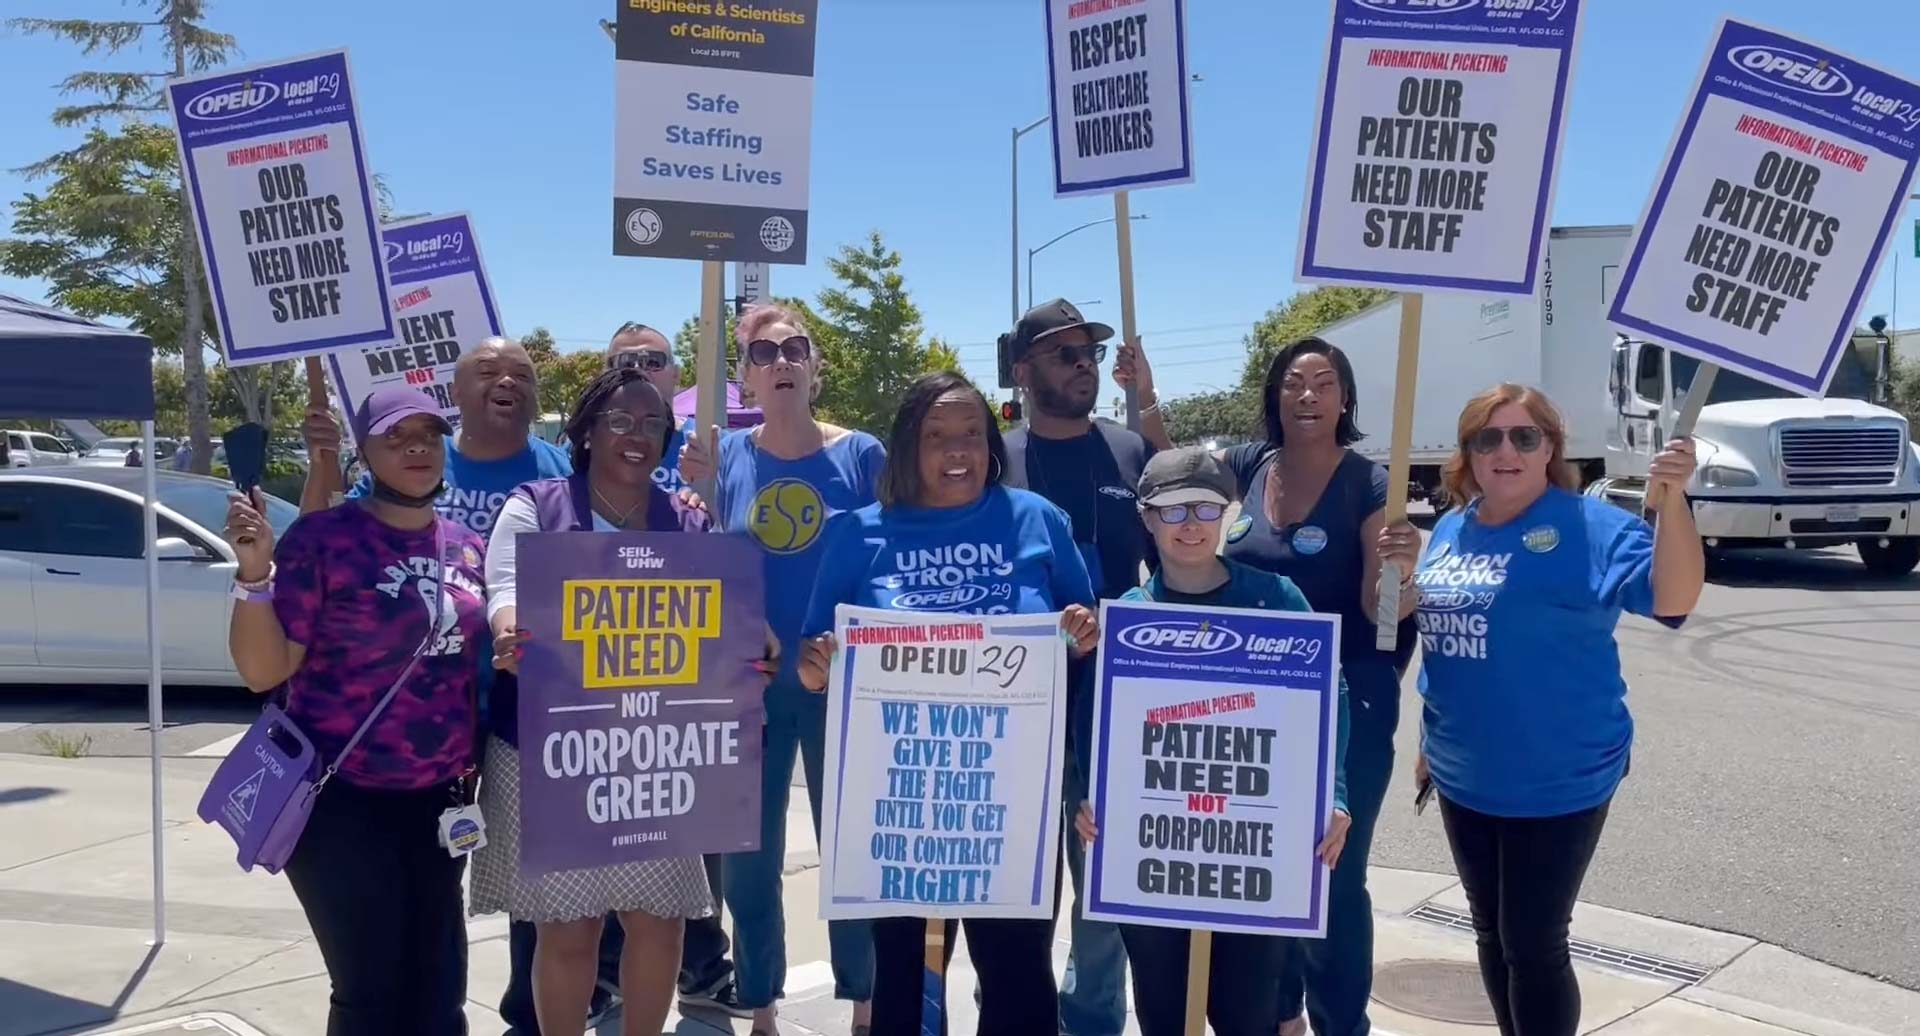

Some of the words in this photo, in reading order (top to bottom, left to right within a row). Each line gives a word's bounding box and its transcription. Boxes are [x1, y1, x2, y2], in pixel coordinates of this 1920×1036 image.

[629, 0, 711, 15] Engineers
[714, 4, 727, 16] &
[730, 4, 805, 25] Scientists
[670, 23, 688, 36] of
[690, 23, 765, 44] California
[690, 48, 710, 56] Local
[1069, 14, 1147, 71] RESPECT
[1367, 49, 1449, 71] INFORMATIONAL
[1450, 53, 1508, 73] PICKETING
[196, 86, 265, 115] OPEIU
[284, 76, 318, 98] Local
[318, 73, 340, 98] 29
[686, 92, 740, 114] Safe
[1073, 71, 1149, 116] HEALTHCARE
[1397, 76, 1463, 118] OUR
[1743, 50, 1840, 91] OPEIU
[1852, 85, 1902, 115] Local
[1894, 102, 1920, 132] 29
[227, 140, 288, 166] INFORMATIONAL
[289, 134, 328, 155] PICKETING
[665, 125, 762, 155] Staffing
[1075, 109, 1154, 158] WORKERS
[1357, 116, 1498, 164] PATIENTS
[1735, 114, 1818, 156] INFORMATIONAL
[1813, 143, 1868, 172] PICKETING
[258, 163, 308, 203] OUR
[642, 157, 714, 180] Saves
[722, 163, 782, 185] Lives
[1351, 163, 1413, 206] NEED
[1415, 167, 1488, 211] MORE
[1753, 151, 1821, 205] OUR
[240, 194, 343, 245] PATIENTS
[1363, 208, 1464, 252] STAFF
[1702, 178, 1840, 257] PATIENTS
[248, 247, 295, 286] NEED
[295, 237, 350, 279] MORE
[407, 235, 441, 255] Local
[442, 232, 463, 254] 29
[1684, 224, 1752, 278] NEED
[1746, 244, 1821, 302] MORE
[268, 279, 341, 323] STAFF
[1685, 272, 1787, 336] STAFF
[365, 341, 461, 376] NEED
[404, 368, 435, 385] NOT
[434, 487, 507, 509] UNIO
[618, 547, 655, 558] SEIU-
[626, 558, 665, 569] UHW
[896, 543, 1003, 571] UNION
[574, 586, 712, 631] PATIENT
[903, 586, 975, 606] OPEIU
[991, 583, 1012, 600] 29
[1476, 592, 1496, 610] 29
[846, 626, 928, 645] INFORMATIONAL
[930, 623, 984, 642] PICKETING
[1416, 612, 1488, 636] BRING
[597, 634, 686, 678] NEED
[1133, 627, 1228, 650] OPEIU
[1245, 633, 1293, 654] Local
[1291, 638, 1322, 665] 29
[1442, 635, 1487, 659] ON!
[881, 645, 967, 676] OPEIU
[977, 645, 1028, 688] 29
[622, 692, 660, 718] NOT
[881, 701, 919, 735] WE
[928, 703, 1009, 739] WON'T
[1146, 701, 1211, 724] INFORMATIONAL
[1212, 692, 1256, 714] PICKETING
[543, 721, 740, 779] CORPORATE
[893, 738, 952, 768] GIVE
[959, 741, 992, 769] UP
[1142, 721, 1277, 764] PATIENT
[255, 745, 286, 779] CAUTION
[1144, 759, 1270, 797] NEED
[586, 772, 696, 824] GREED
[887, 768, 926, 800] THE
[932, 770, 995, 801] FIGHT
[1187, 793, 1227, 814] NOT
[875, 799, 925, 829] UNTIL
[932, 803, 968, 832] YOU
[972, 804, 1007, 832] GET
[612, 831, 668, 847] #UNITED4ALL
[871, 832, 908, 862] OUR
[913, 835, 1004, 866] CONTRACT
[1138, 813, 1273, 857] CORPORATE
[880, 865, 992, 903] RIGHT!
[1137, 858, 1273, 902] GREED
